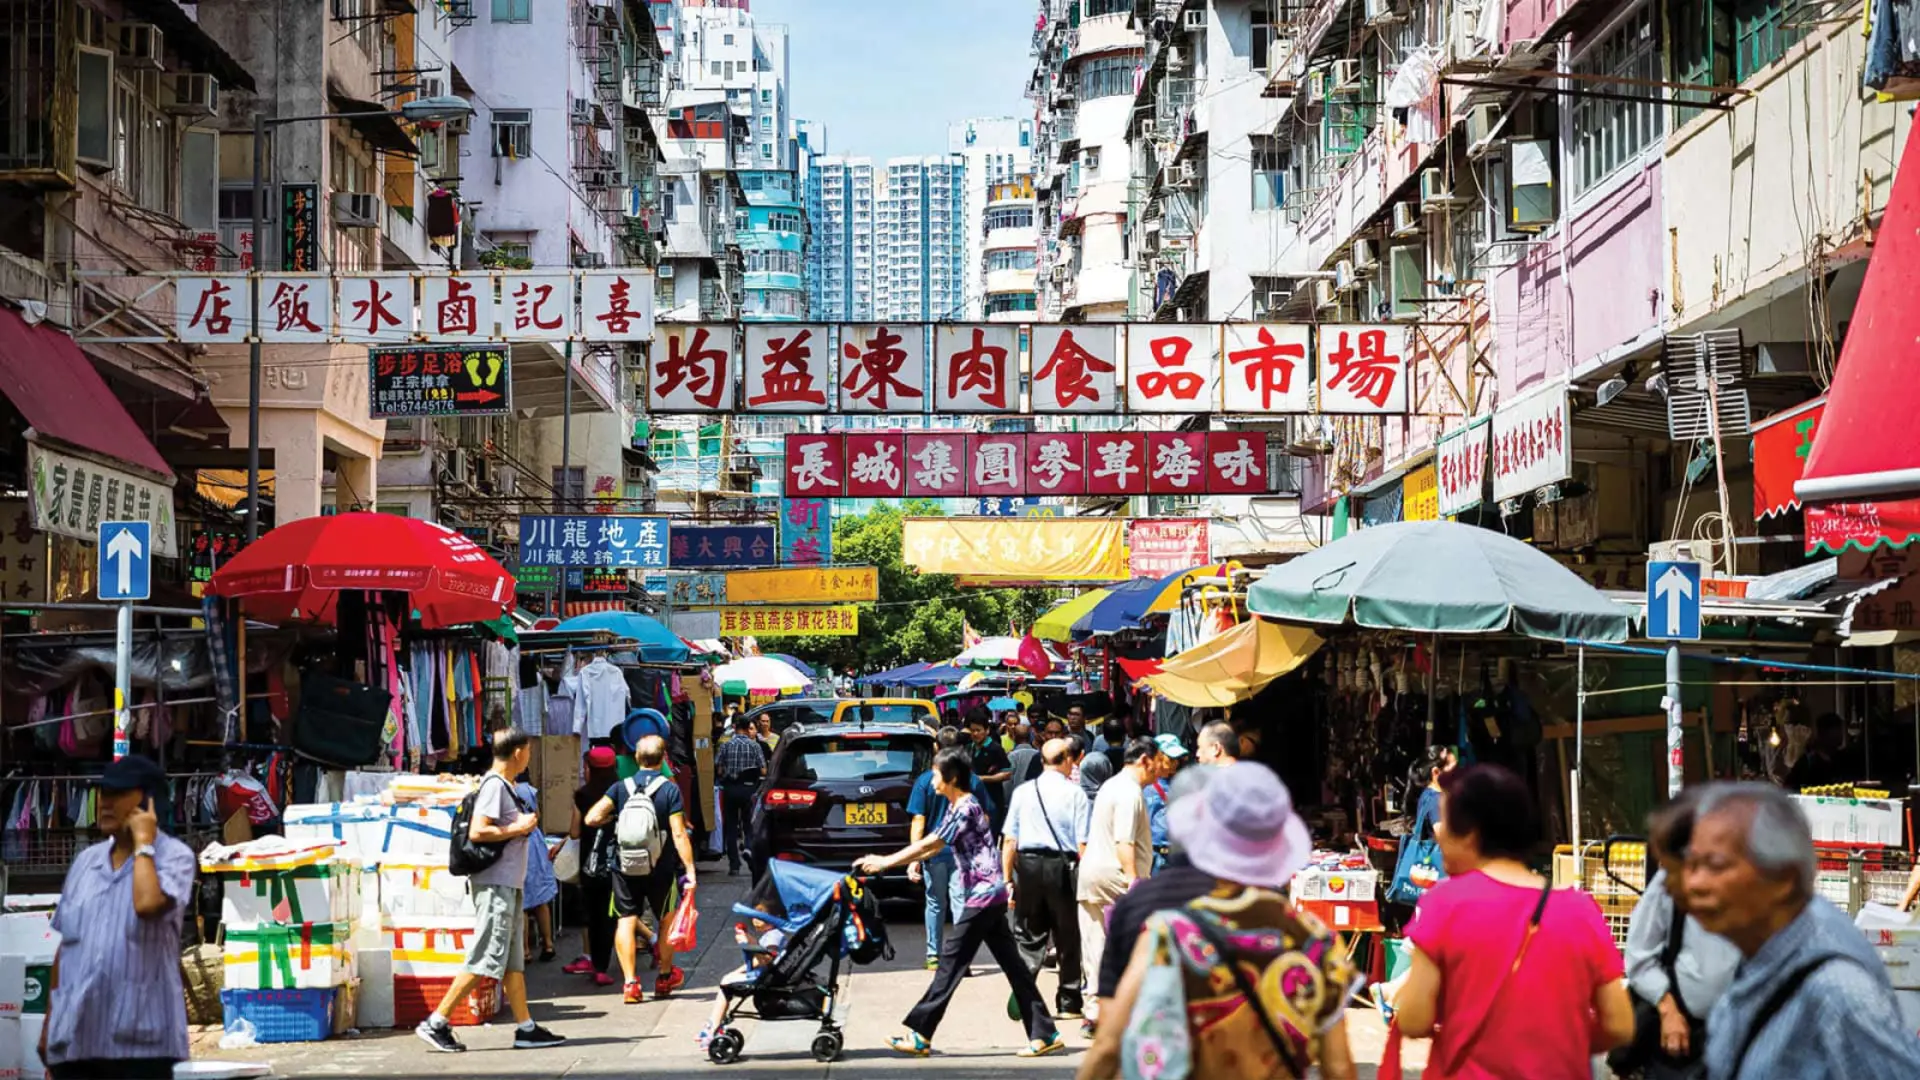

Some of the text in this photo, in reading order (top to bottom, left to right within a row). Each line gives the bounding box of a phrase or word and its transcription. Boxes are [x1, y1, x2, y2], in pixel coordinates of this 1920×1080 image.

[378, 352, 463, 376] 步步足浴
[655, 326, 1400, 410] 均益凍肉食品市場
[391, 374, 450, 388] 正宗推拿
[526, 519, 663, 548] 川龍地產
[525, 549, 662, 565] 川龍裝飾工程
